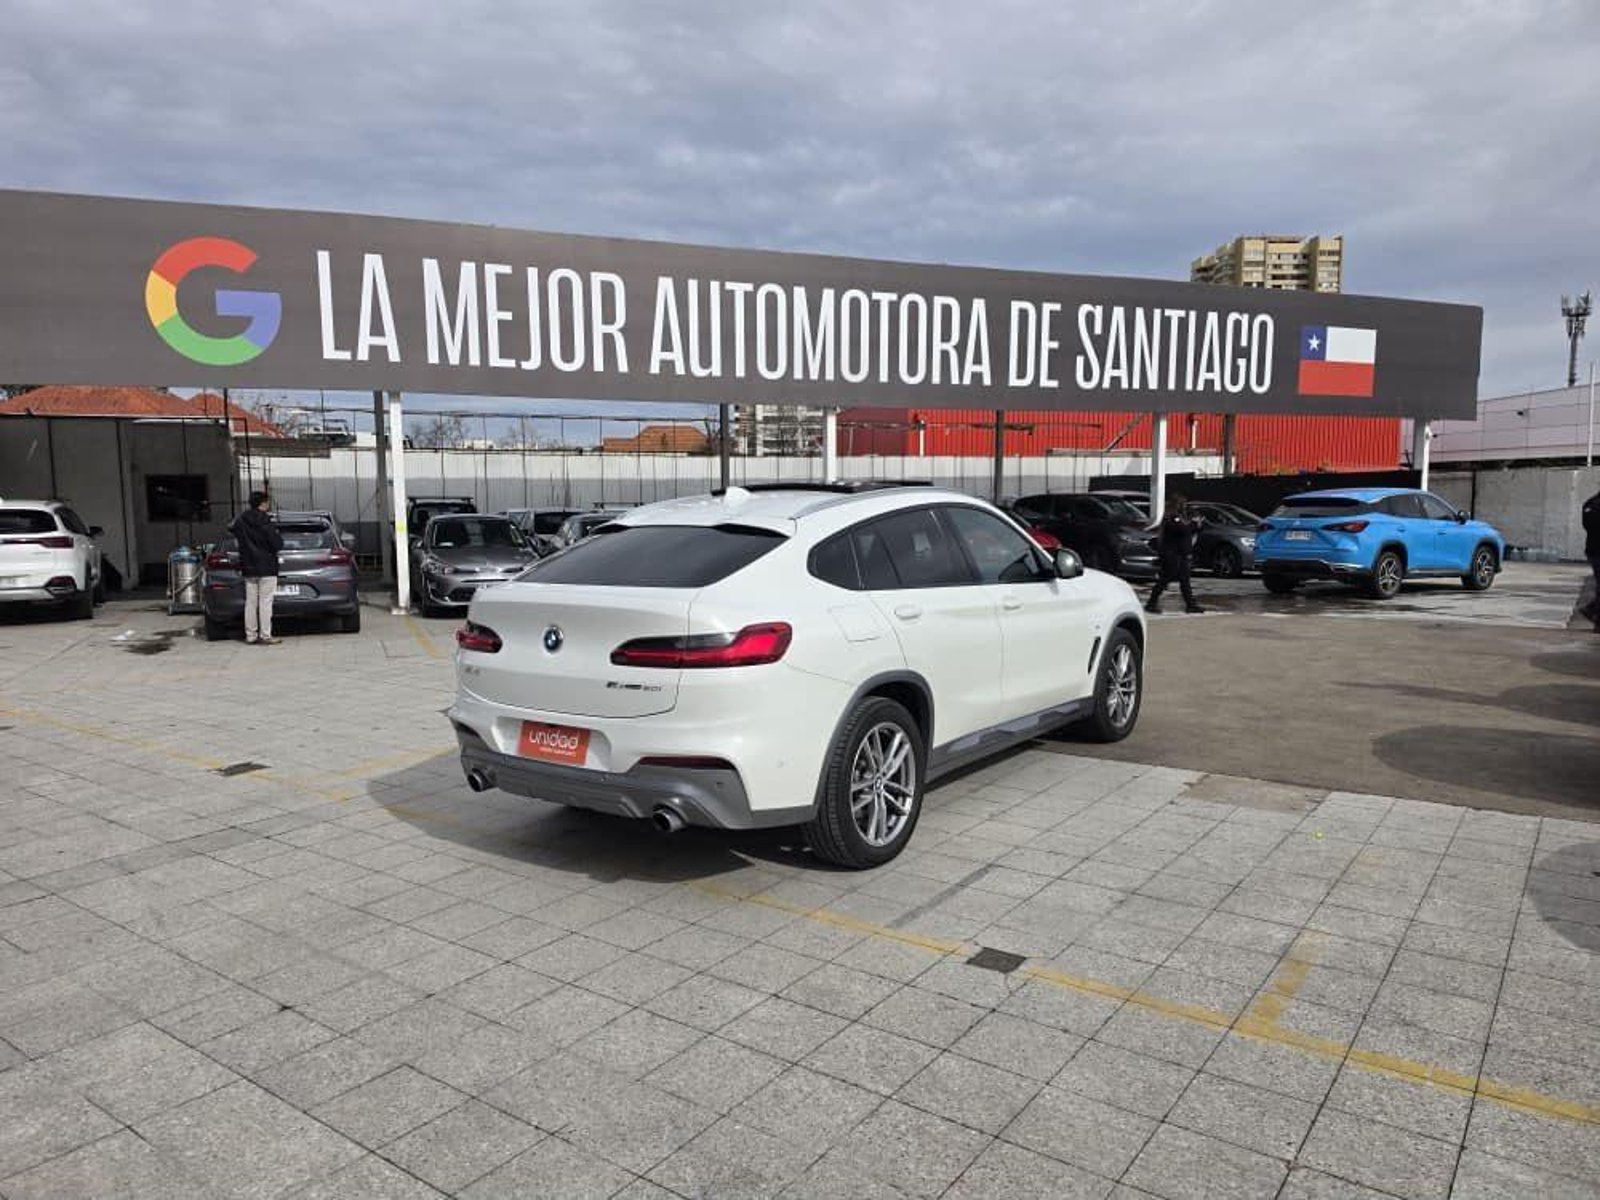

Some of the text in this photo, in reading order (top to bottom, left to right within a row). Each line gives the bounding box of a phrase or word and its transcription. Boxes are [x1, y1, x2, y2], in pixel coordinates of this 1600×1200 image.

[145, 237, 282, 366] G
[316, 249, 1275, 394] LA MEJOR AUTOMOTORA DE SANTIAGO
[528, 728, 579, 750] unidad
